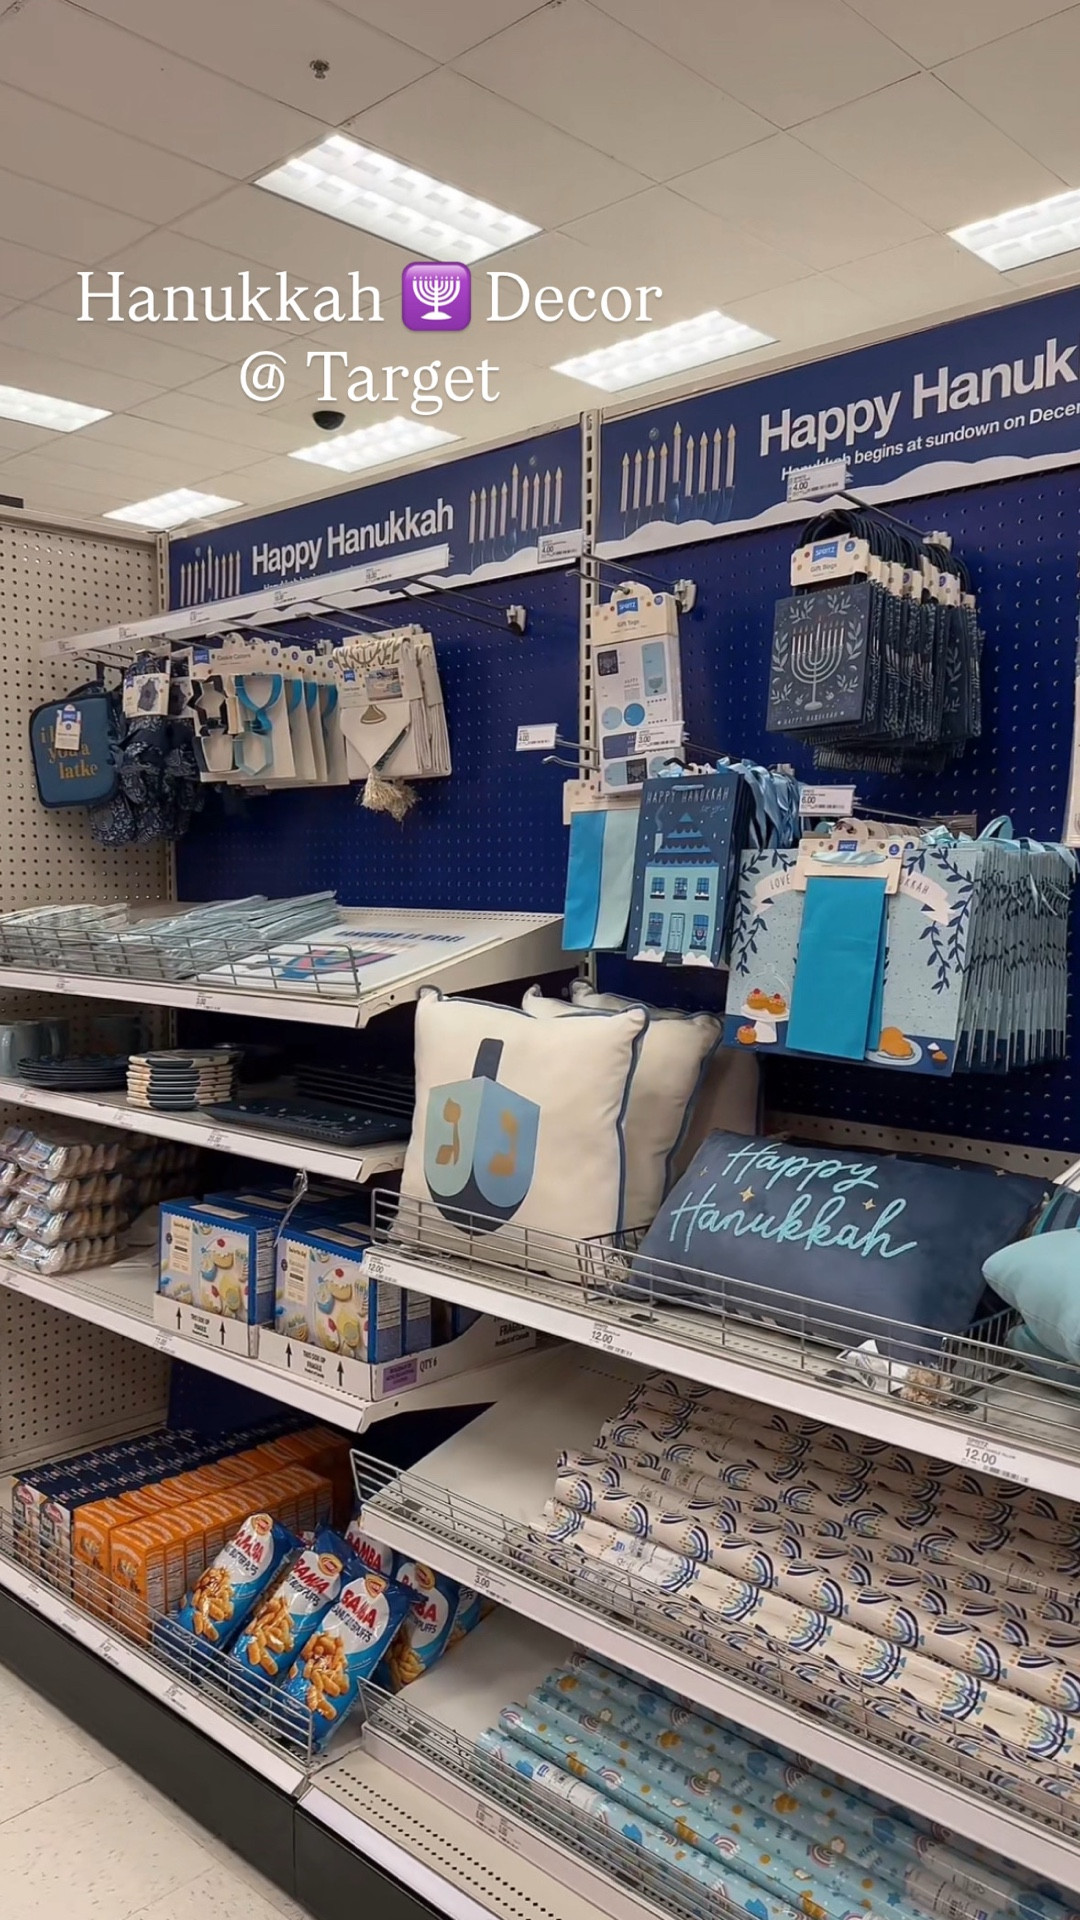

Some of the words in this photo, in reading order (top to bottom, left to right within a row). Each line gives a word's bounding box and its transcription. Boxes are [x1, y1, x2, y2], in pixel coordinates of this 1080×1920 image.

[760, 387, 901, 457] Happy
[913, 338, 1079, 419] Hanuk
[855, 441, 904, 465] begins
[907, 434, 923, 453] at
[925, 420, 1000, 446] sundown
[1003, 412, 1025, 431] on
[252, 537, 323, 577] Happy
[327, 498, 454, 558] Hanukkah
[59, 758, 98, 780] latke
[770, 874, 791, 890] LOVE
[721, 1143, 879, 1194] Happy
[669, 1183, 918, 1258] Hanukkah
[368, 1263, 384, 1274] 12.00
[591, 1330, 613, 1344] 12.00
[419, 1358, 433, 1373] QTY
[964, 1447, 997, 1465] 12.00
[474, 1575, 490, 1588] 3.00
